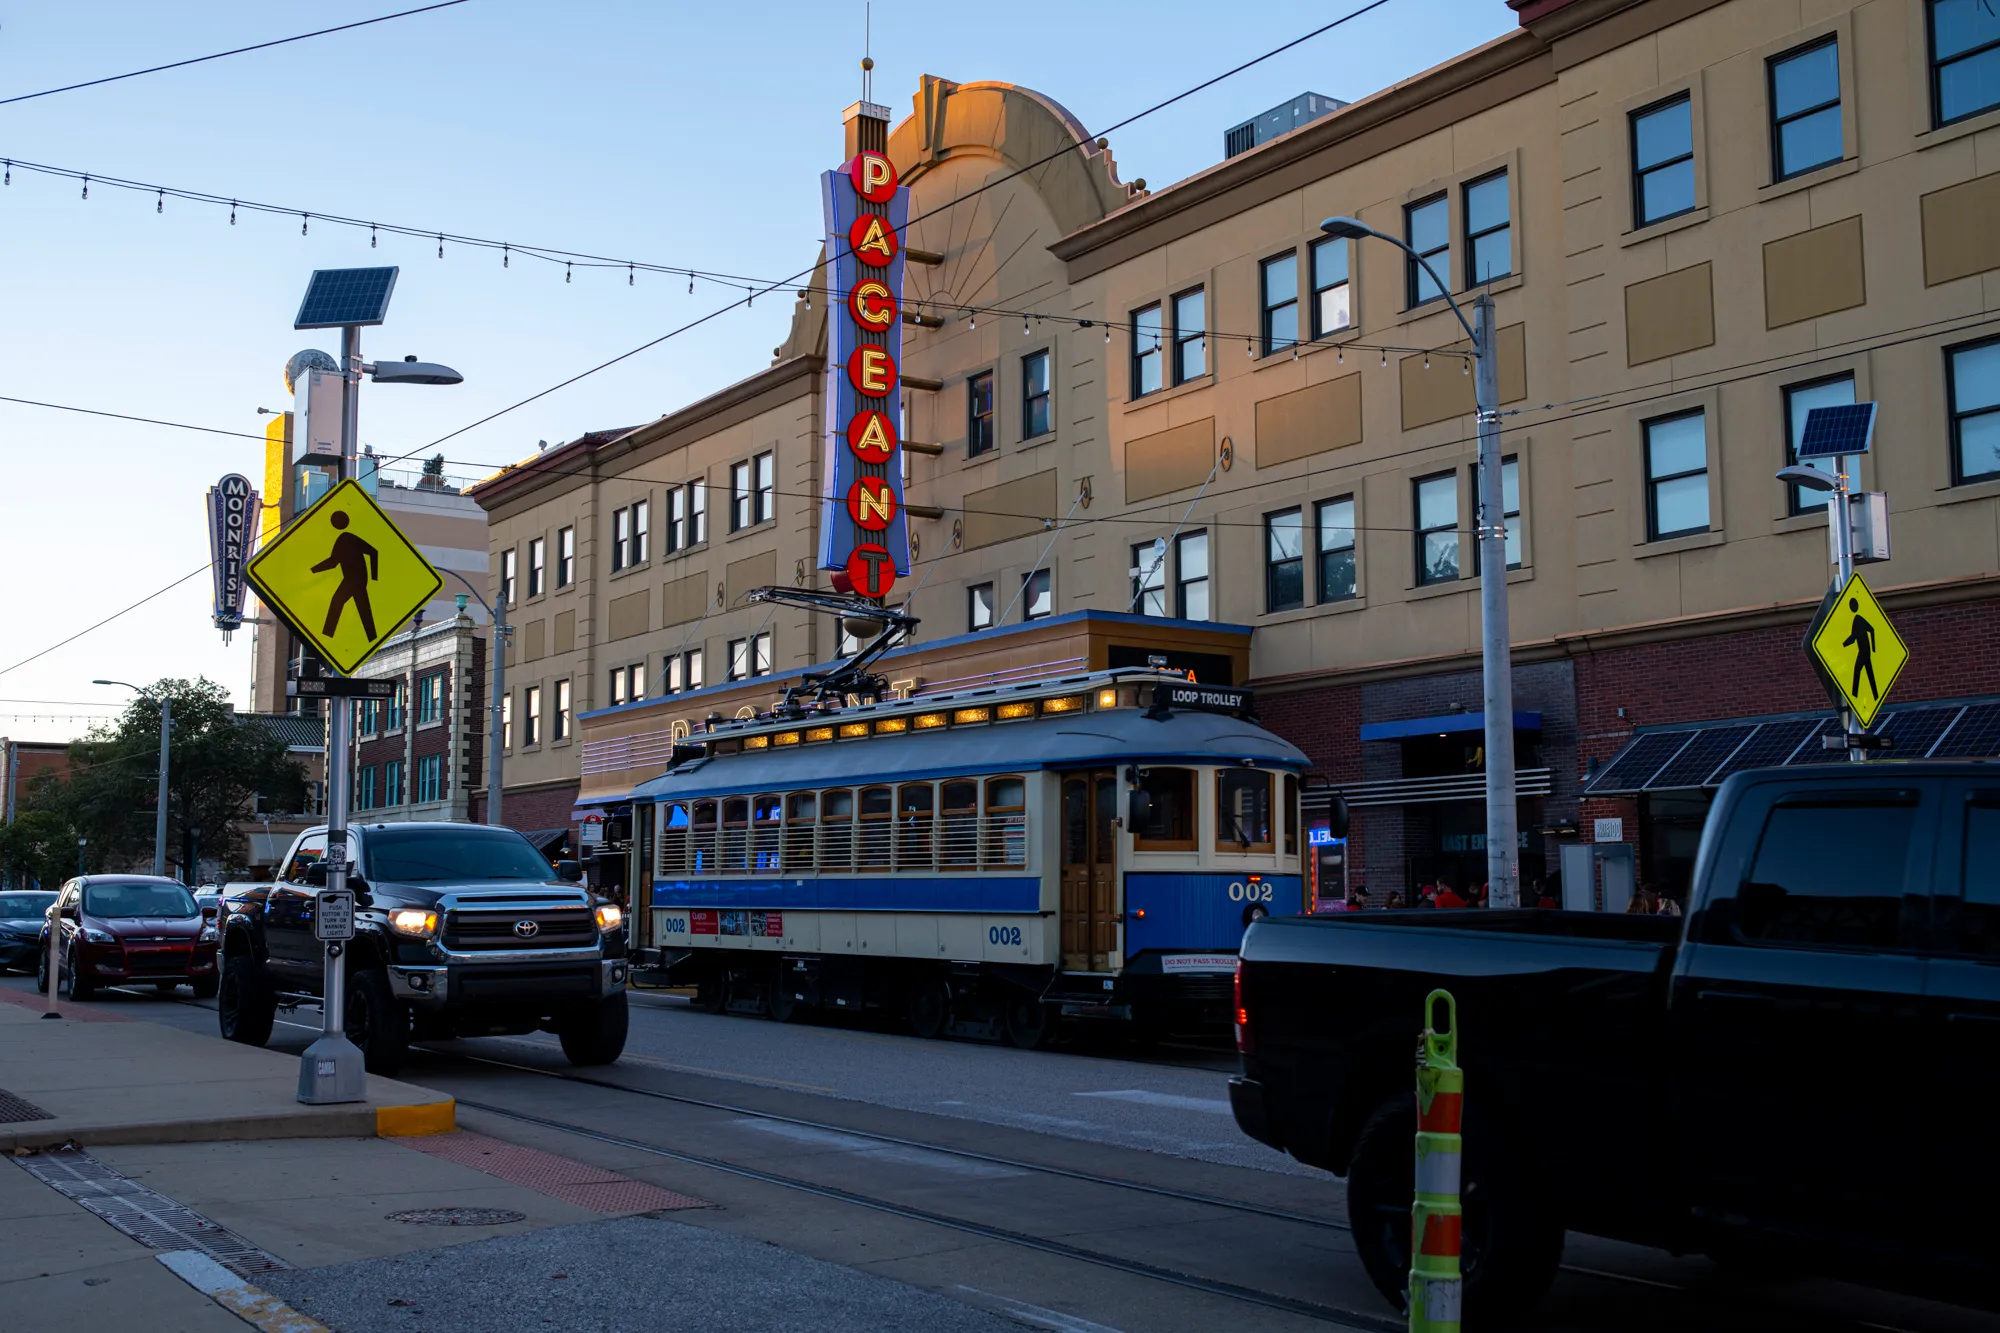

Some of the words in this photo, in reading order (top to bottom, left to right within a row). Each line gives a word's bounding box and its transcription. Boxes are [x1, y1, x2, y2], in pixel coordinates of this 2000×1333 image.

[860, 103, 890, 119] THE
[854, 152, 893, 594] PAGEANT
[225, 480, 246, 607] MOONRISE
[215, 613, 243, 624] Hotel
[1172, 689, 1199, 703] LOOP
[1199, 691, 1243, 707] TROLLEY
[1441, 834, 1468, 852] EAST
[1228, 881, 1273, 902] 002
[665, 918, 685, 933] 002
[989, 926, 1021, 946] 002
[1193, 957, 1210, 965] PASS
